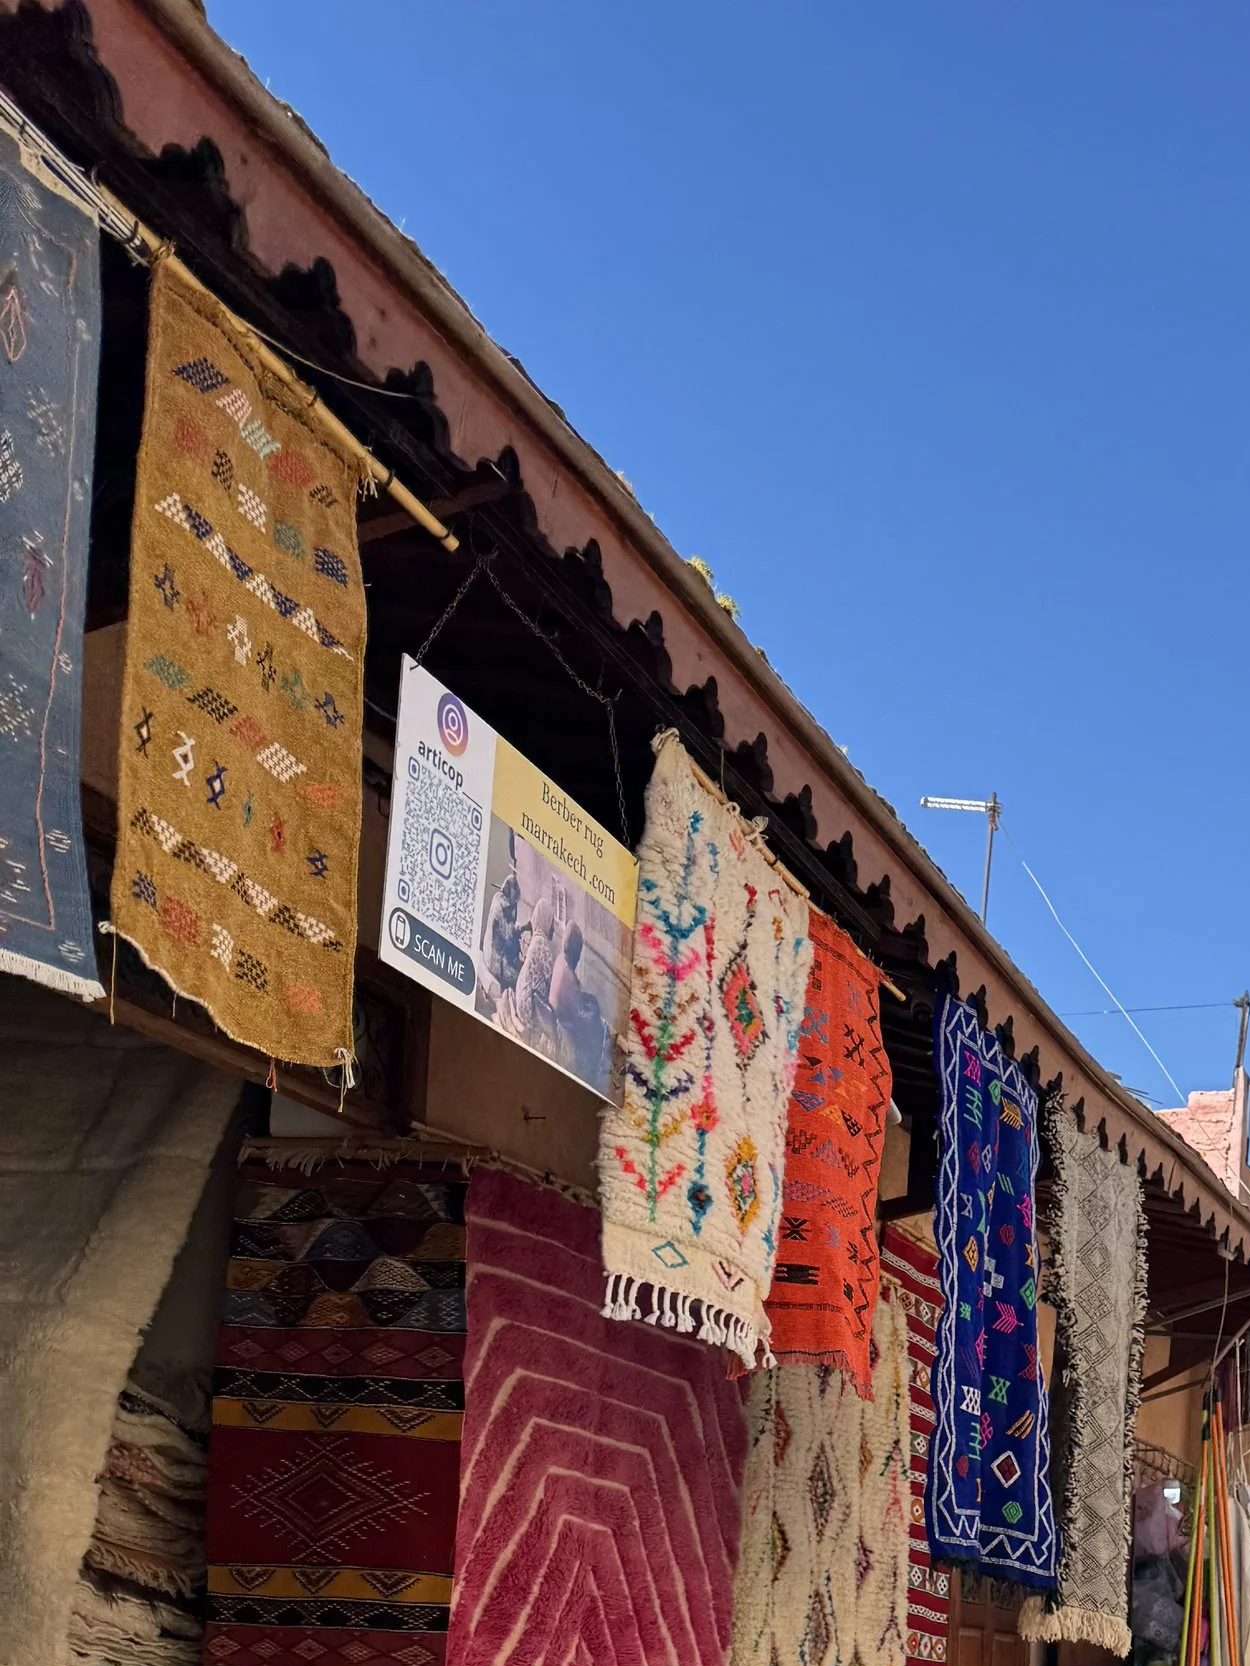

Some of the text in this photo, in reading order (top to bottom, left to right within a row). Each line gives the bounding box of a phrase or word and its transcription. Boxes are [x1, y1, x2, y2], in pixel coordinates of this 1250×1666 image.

[521, 812, 615, 905] marrakech .com
[541, 781, 604, 859] Berber rug
[413, 934, 465, 982] SCAN ME
